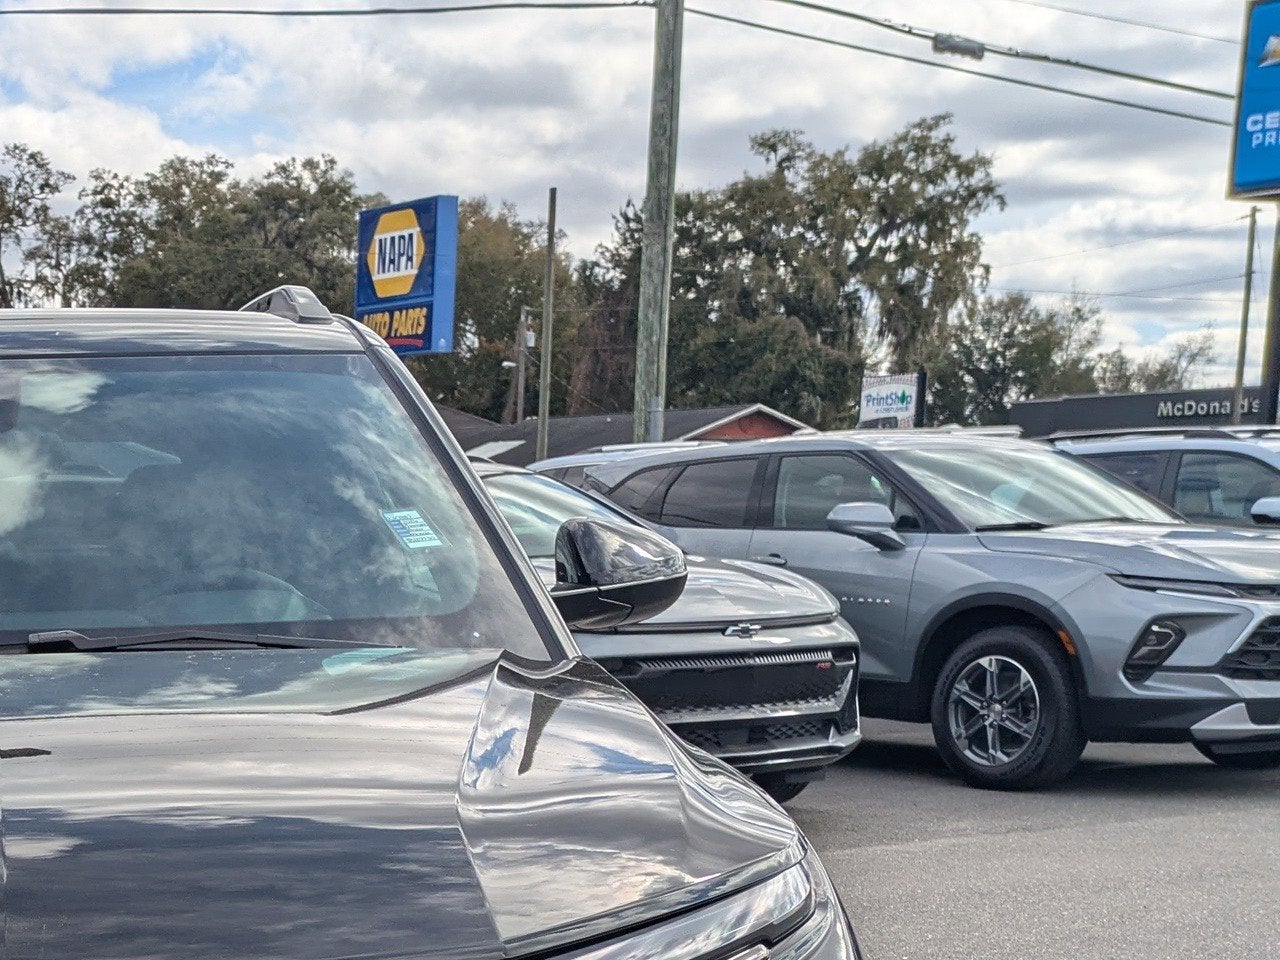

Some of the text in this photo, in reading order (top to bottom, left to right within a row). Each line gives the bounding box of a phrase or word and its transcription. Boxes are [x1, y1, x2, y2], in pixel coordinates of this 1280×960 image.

[1252, 130, 1280, 149] PR
[377, 232, 414, 275] NAPA
[390, 306, 428, 337] PARTS
[1157, 397, 1261, 417] McDonad's
